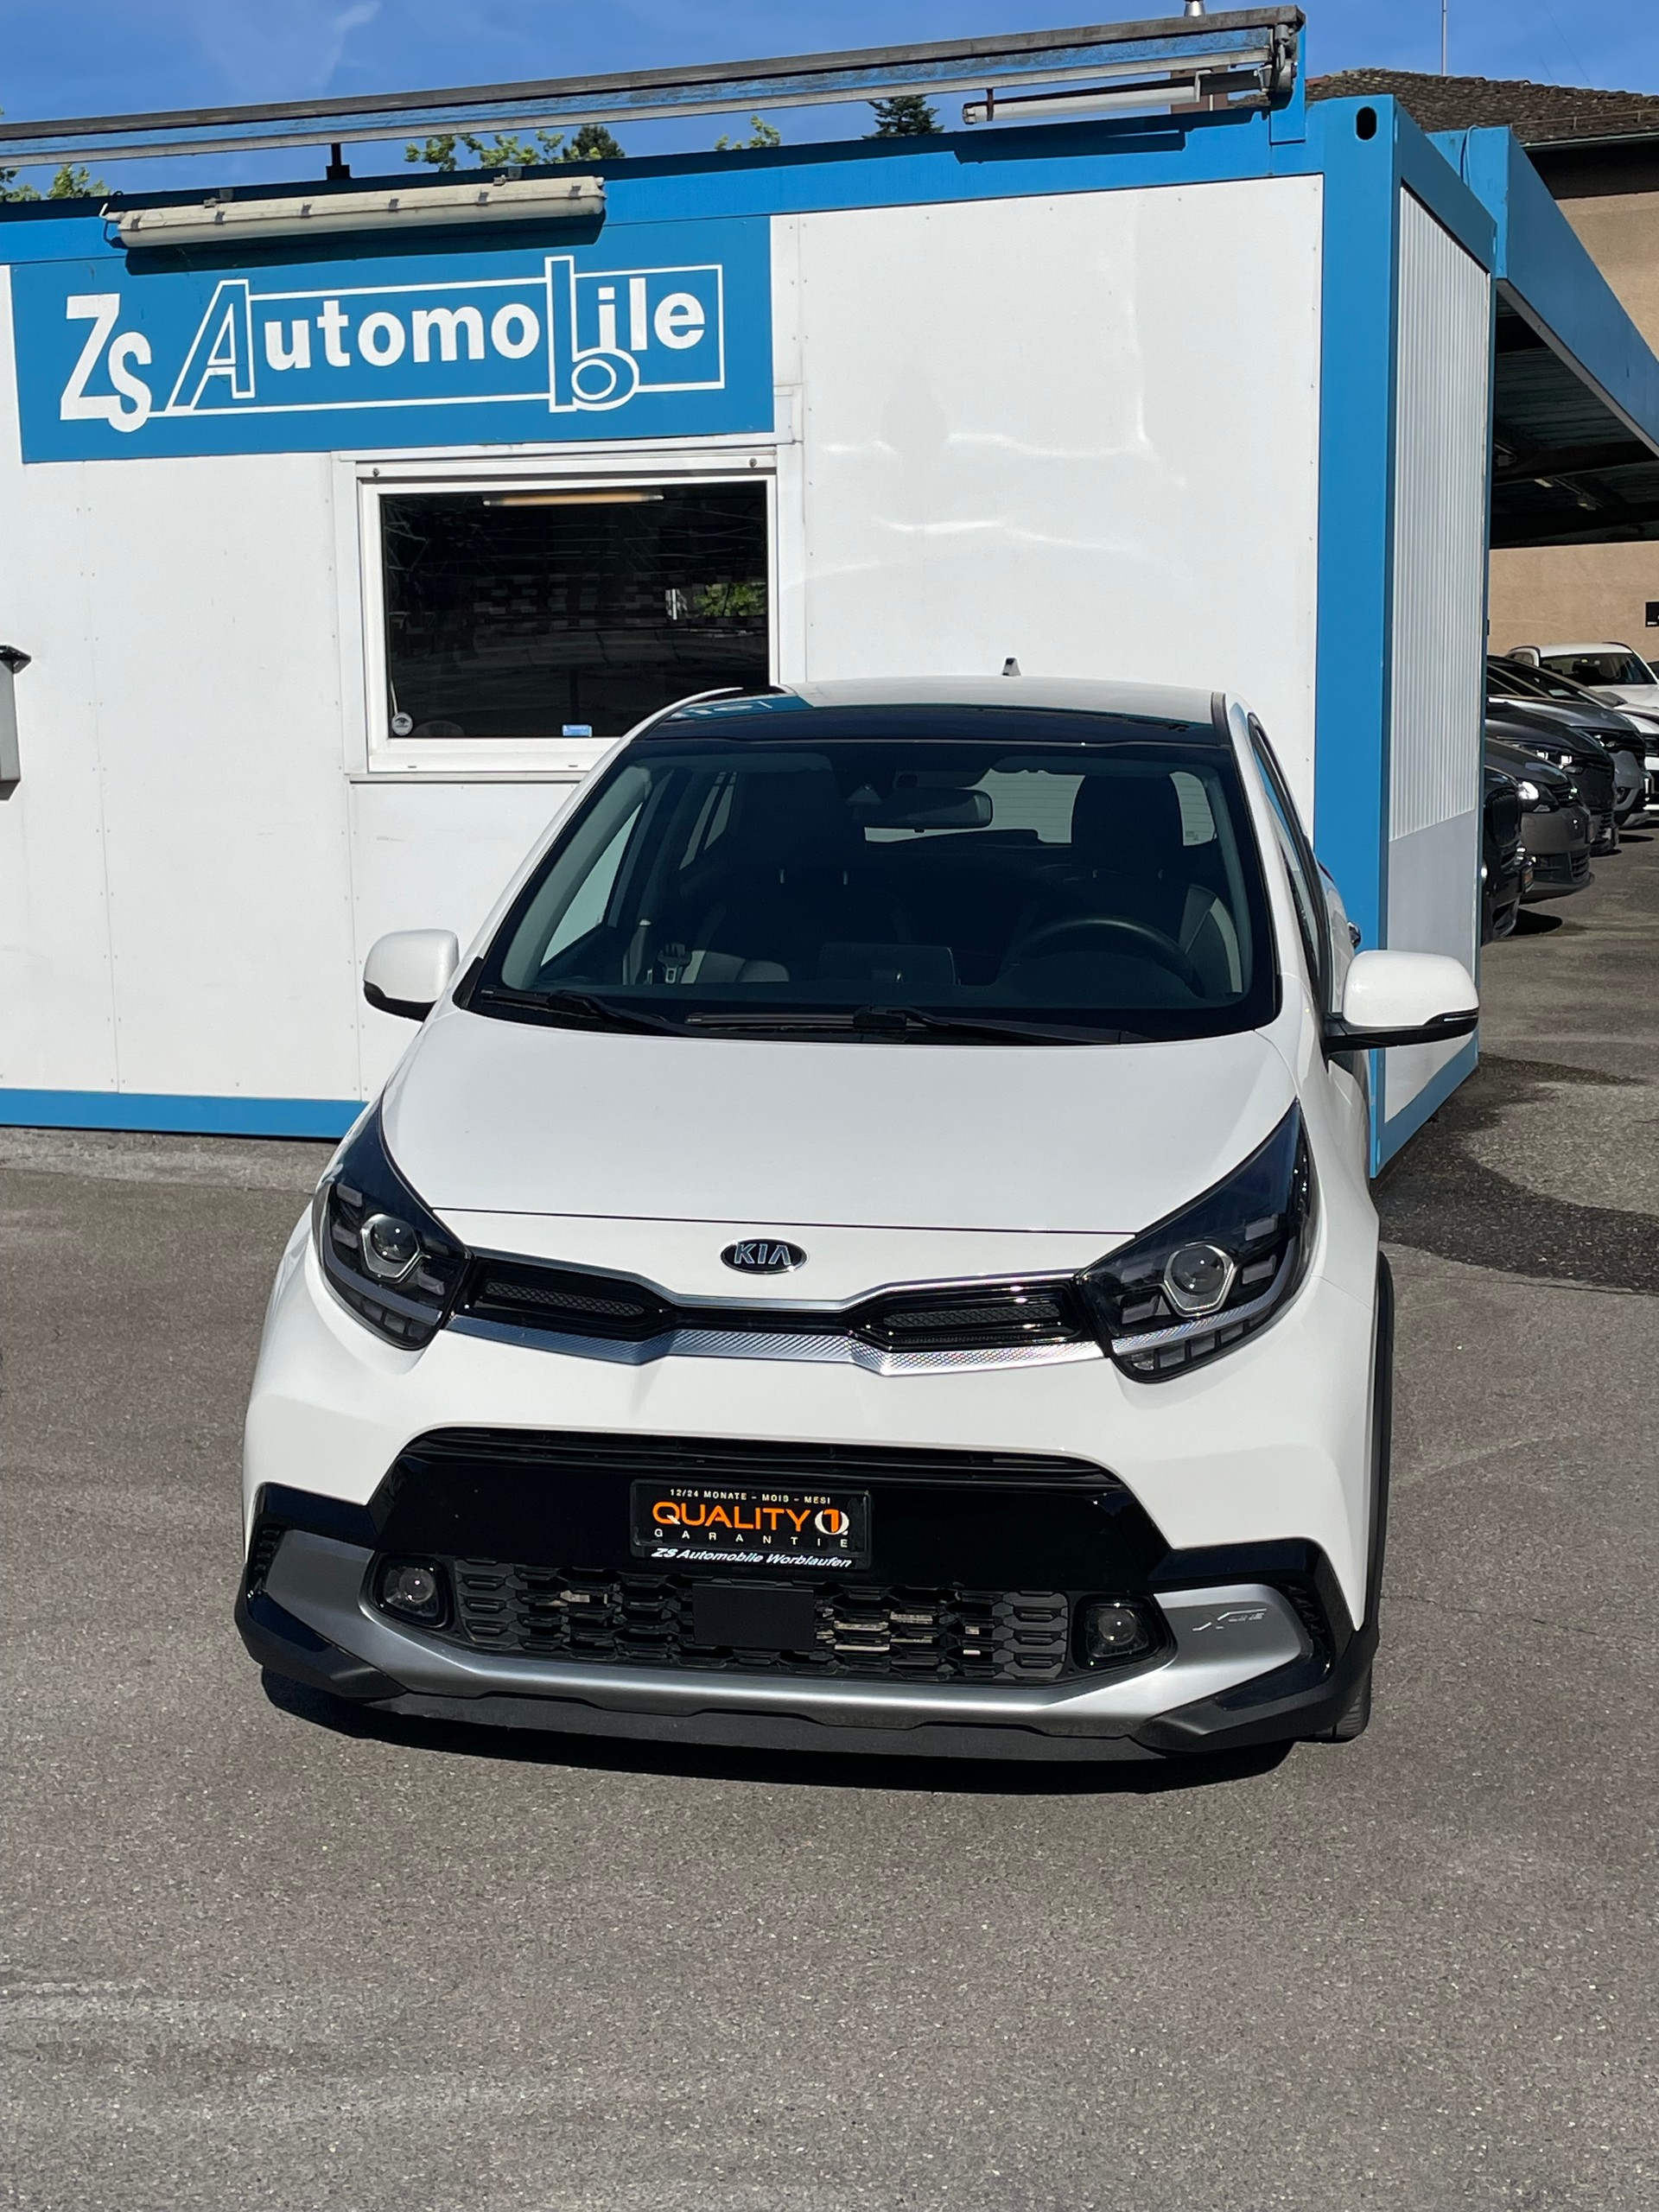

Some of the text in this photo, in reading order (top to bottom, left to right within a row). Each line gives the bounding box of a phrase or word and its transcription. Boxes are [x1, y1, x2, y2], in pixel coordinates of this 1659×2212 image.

[164, 256, 707, 414] Automobile
[734, 1243, 792, 1266] KIA
[670, 1488, 700, 1497] 12/24
[703, 1491, 747, 1500] MONATE
[761, 1493, 790, 1503] MOIS
[804, 1496, 830, 1504] MESI
[652, 1501, 811, 1532] QUALITY
[654, 1528, 849, 1548] GARANTIE
[651, 1548, 852, 1568] ZS Automobile Worblaufen
